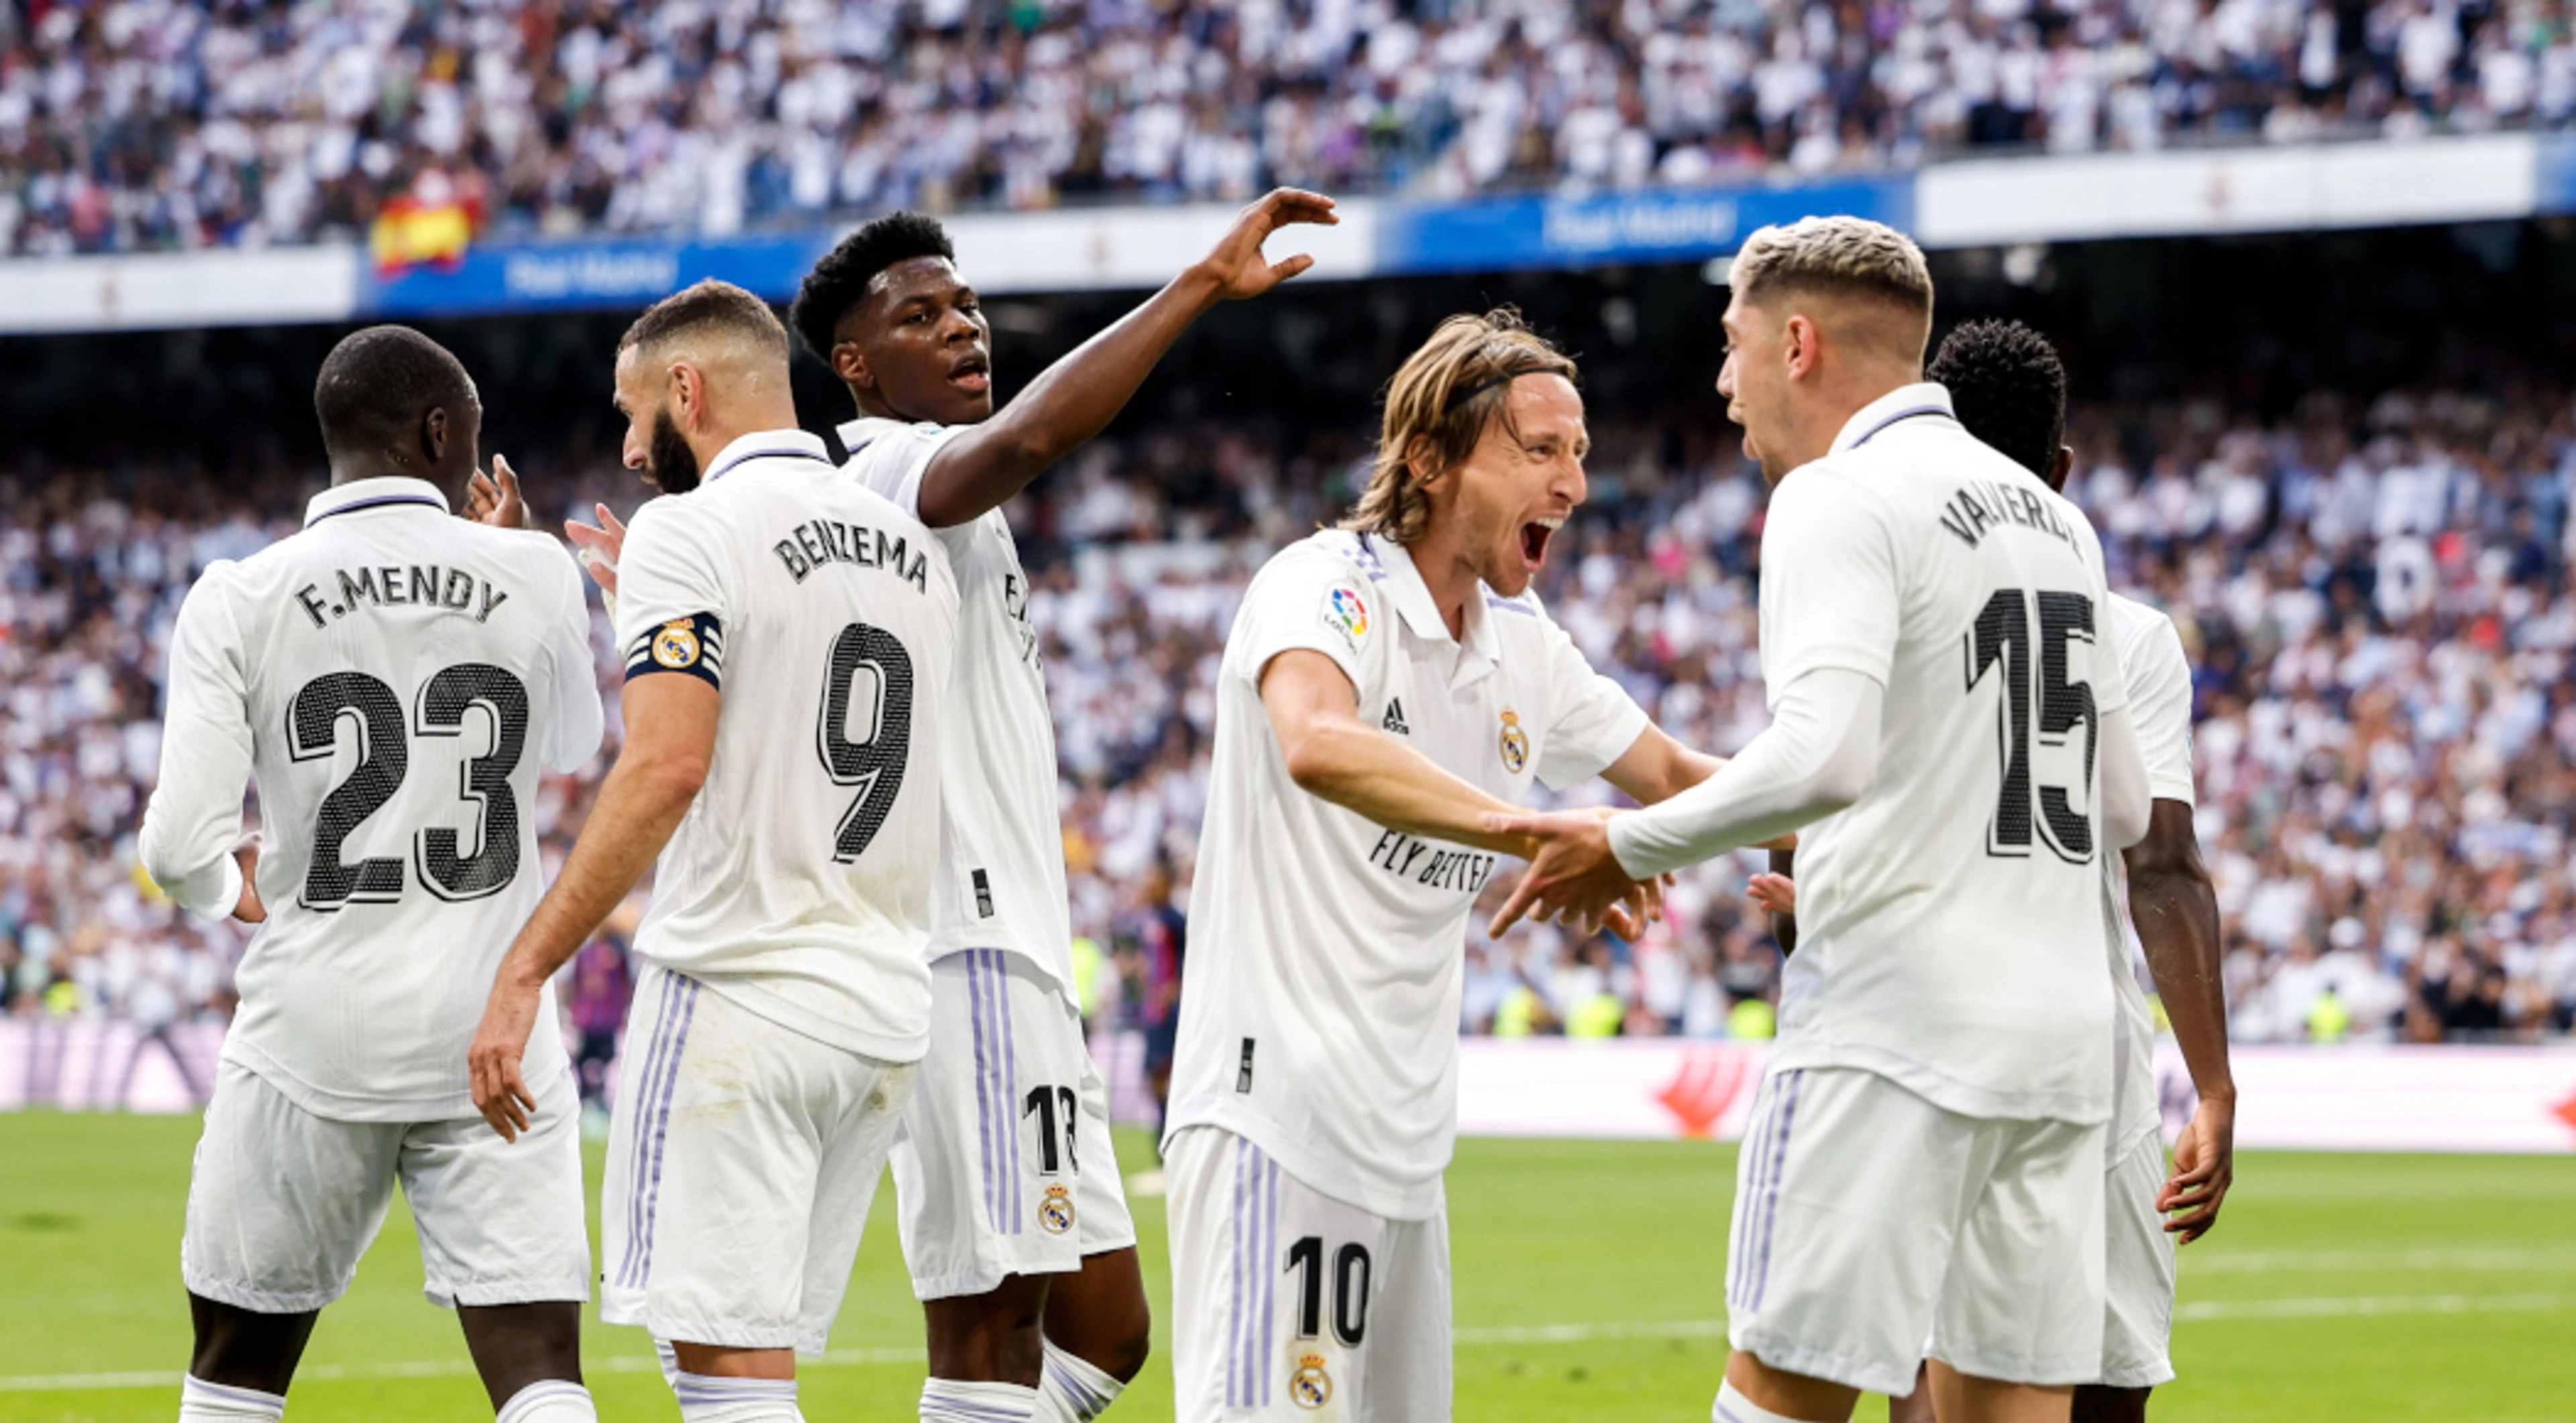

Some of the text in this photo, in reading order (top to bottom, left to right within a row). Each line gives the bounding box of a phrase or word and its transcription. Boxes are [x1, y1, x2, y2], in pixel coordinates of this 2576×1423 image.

[294, 564, 508, 629] F.MENDY
[773, 519, 927, 595] BENZEMA
[816, 623, 914, 865] 9
[1962, 588, 2098, 865] 15
[286, 663, 529, 912] 23
[1368, 829, 1428, 876] FLY
[1283, 1236, 1371, 1350] 10
